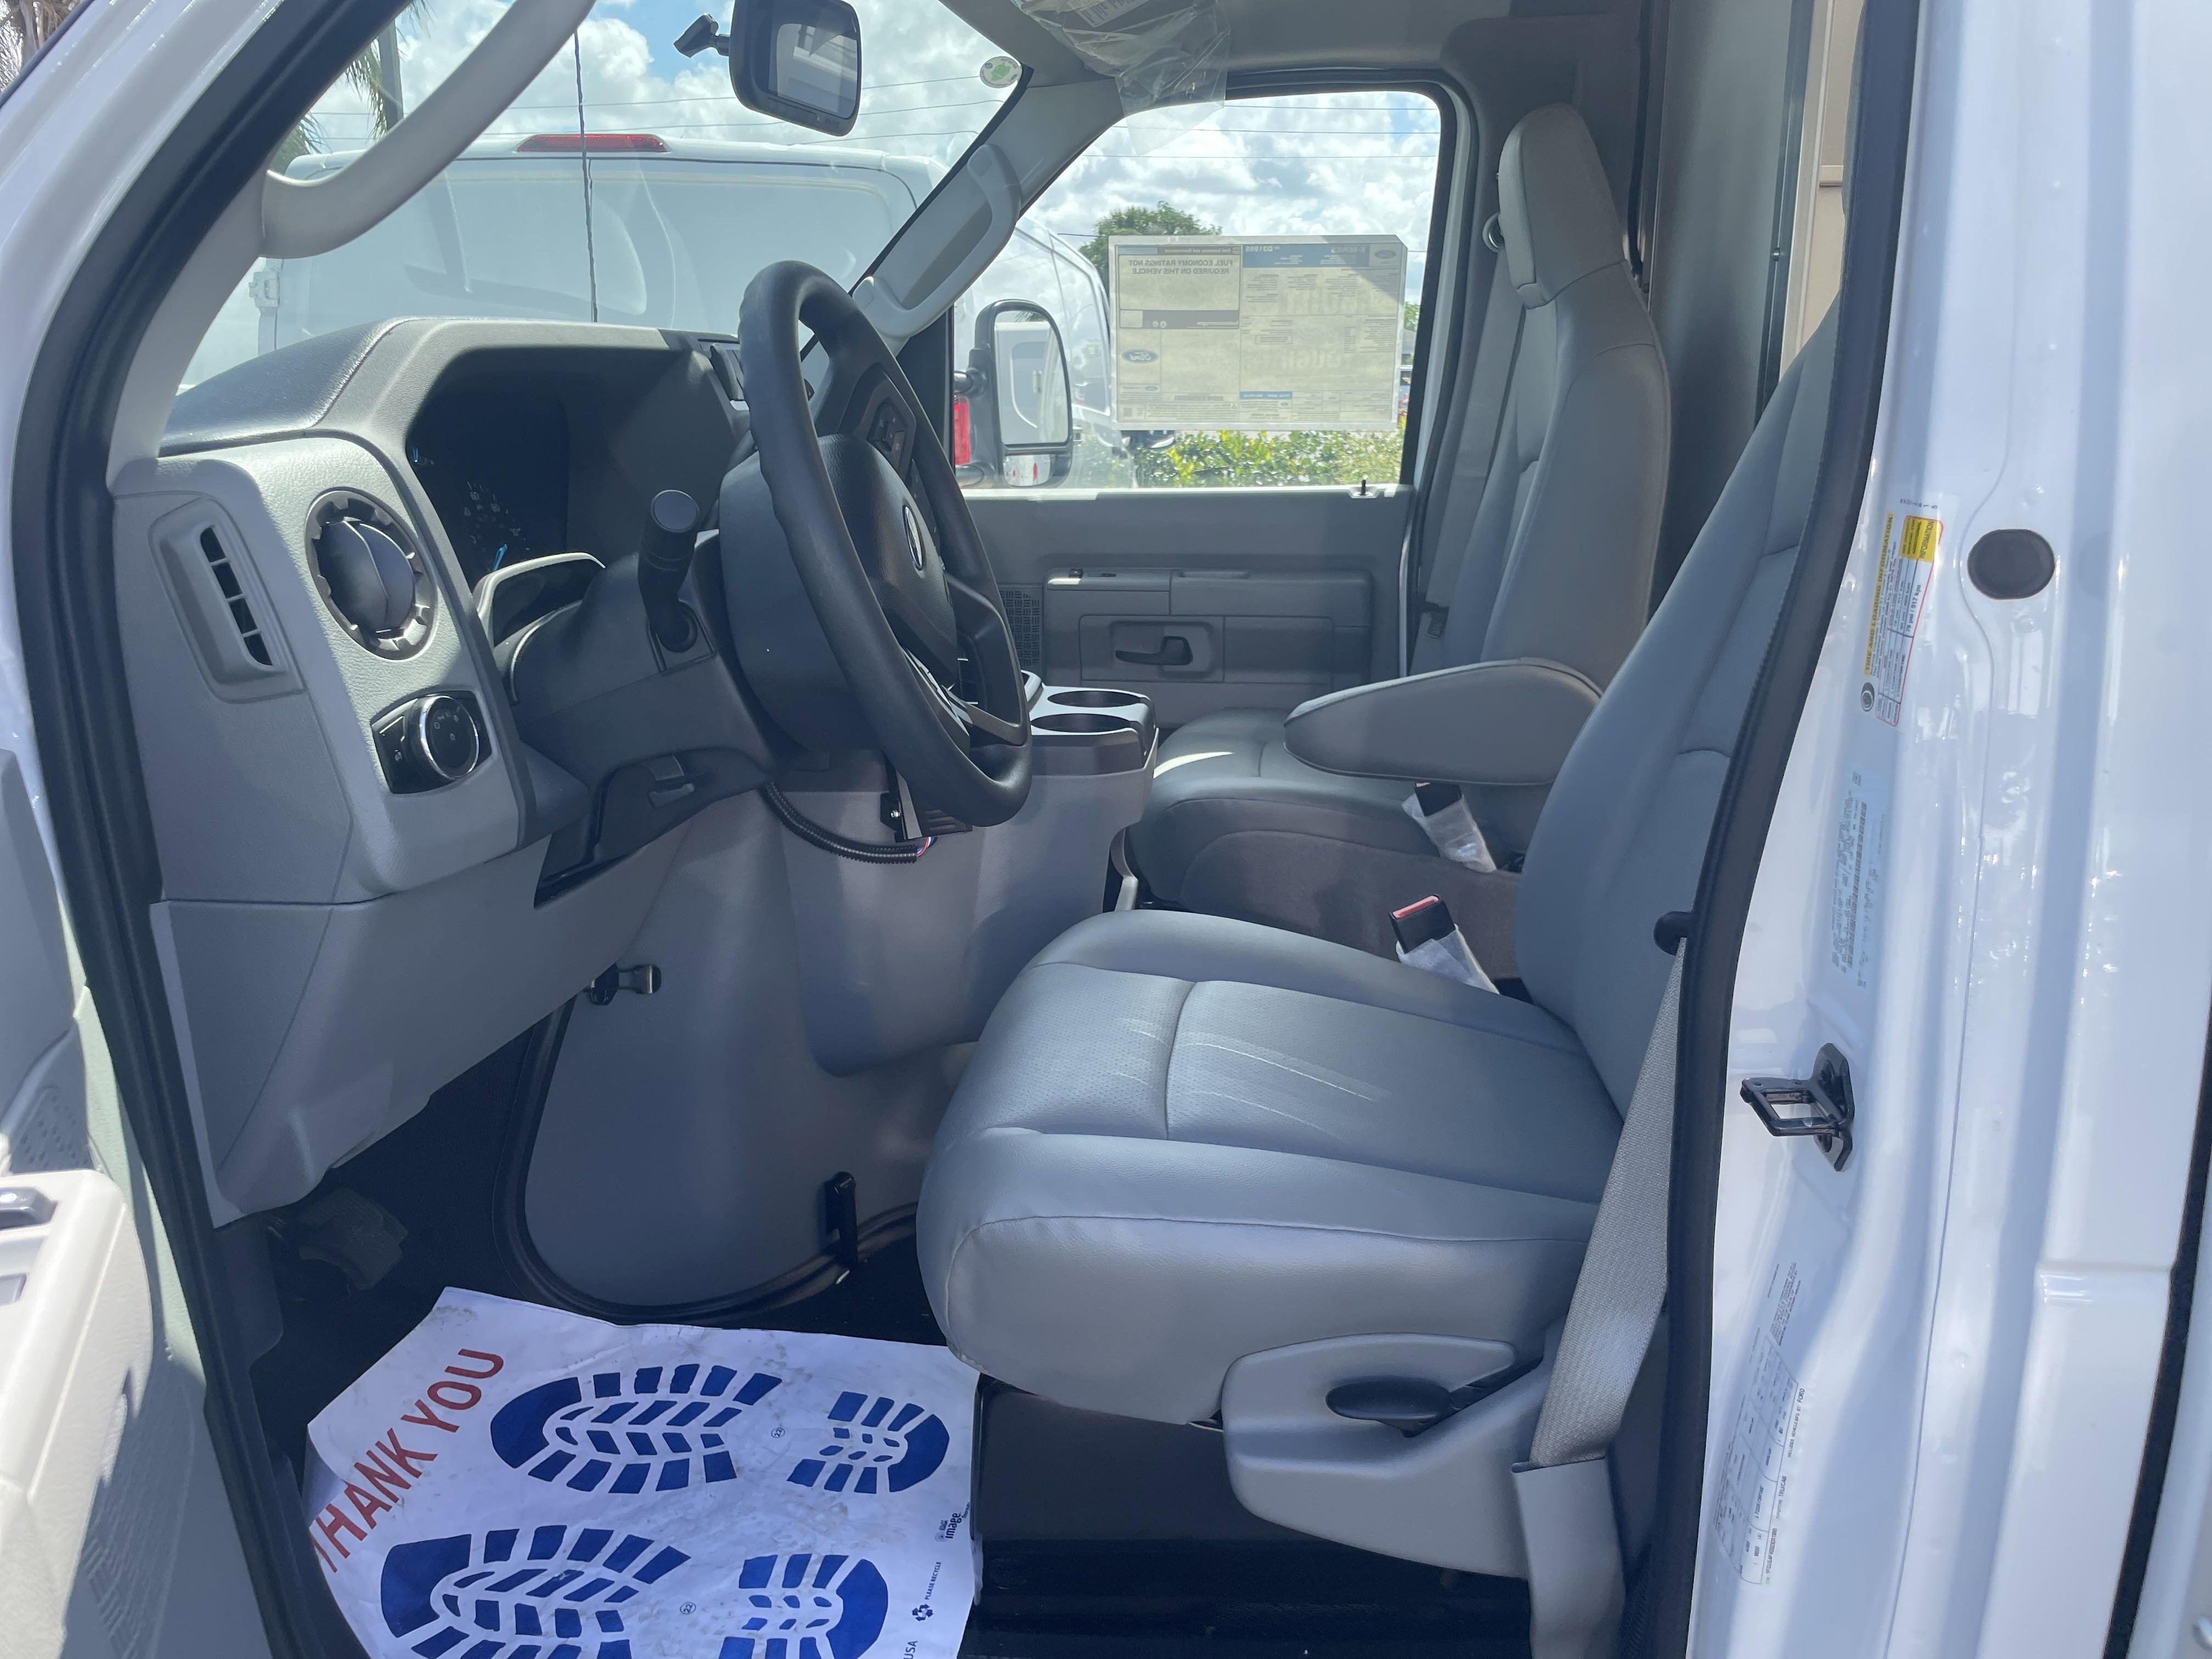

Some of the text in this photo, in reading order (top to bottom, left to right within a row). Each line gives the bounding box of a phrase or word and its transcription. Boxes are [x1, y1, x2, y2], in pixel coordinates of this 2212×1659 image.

[400, 1348, 504, 1433] YOU
[924, 1561, 941, 1600] PLEASE RECYCLE
[903, 1640, 918, 1659] USA
